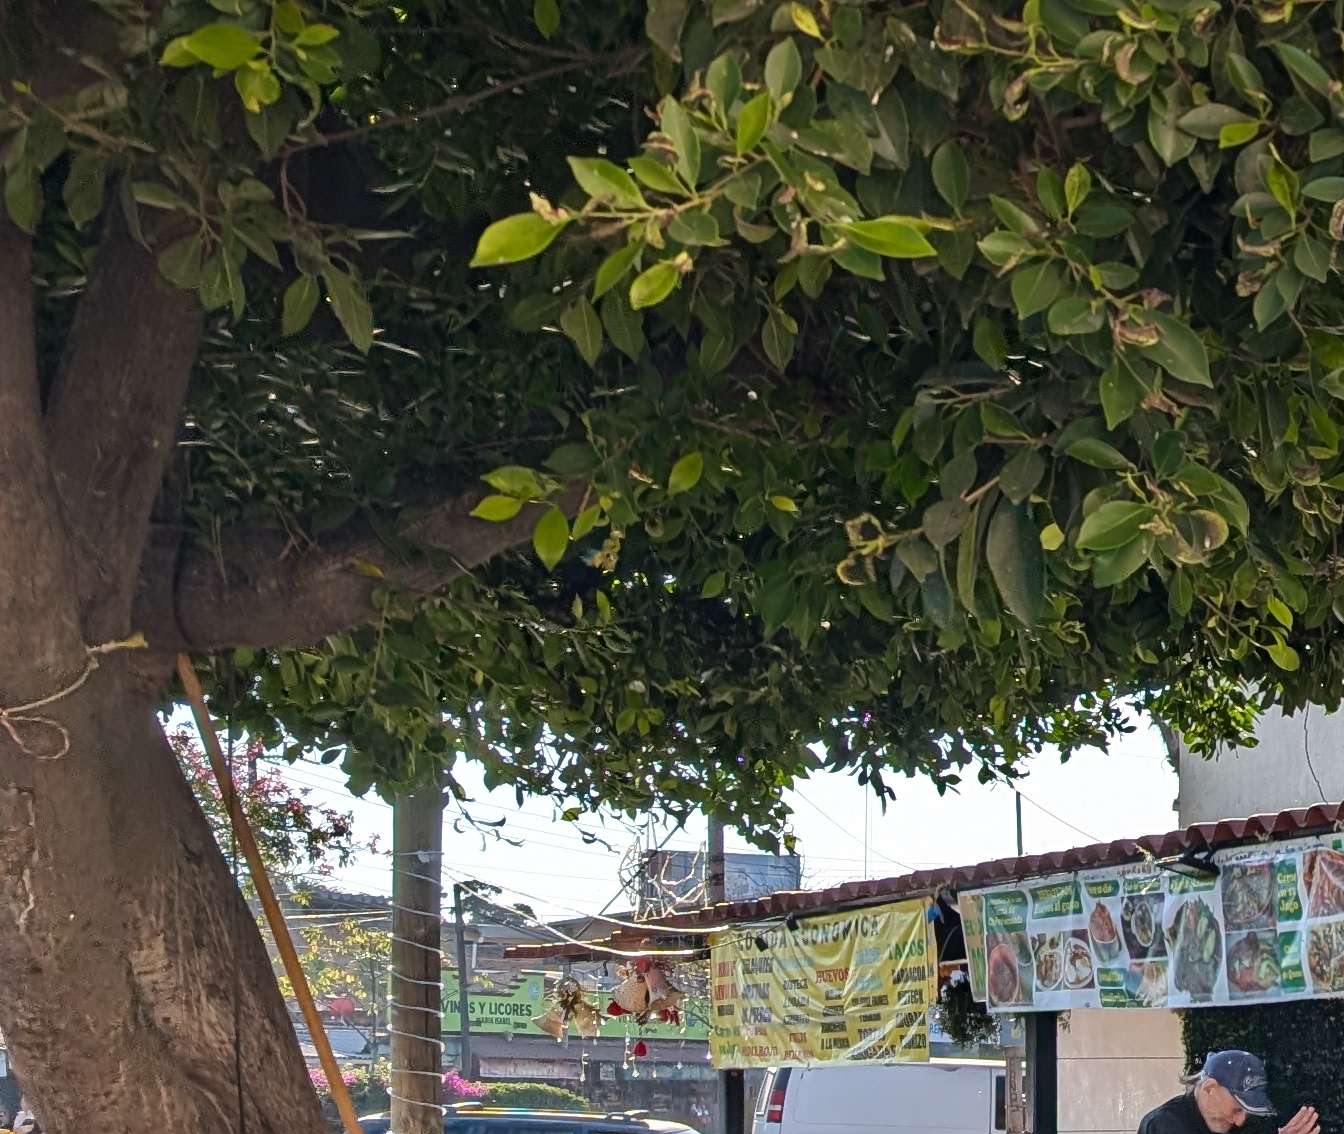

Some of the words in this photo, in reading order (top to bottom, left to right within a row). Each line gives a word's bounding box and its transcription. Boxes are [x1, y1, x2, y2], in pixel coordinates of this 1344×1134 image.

[441, 1000, 476, 1014] VINS
[478, 1001, 487, 1015] Y
[489, 1002, 533, 1017] LICORES
